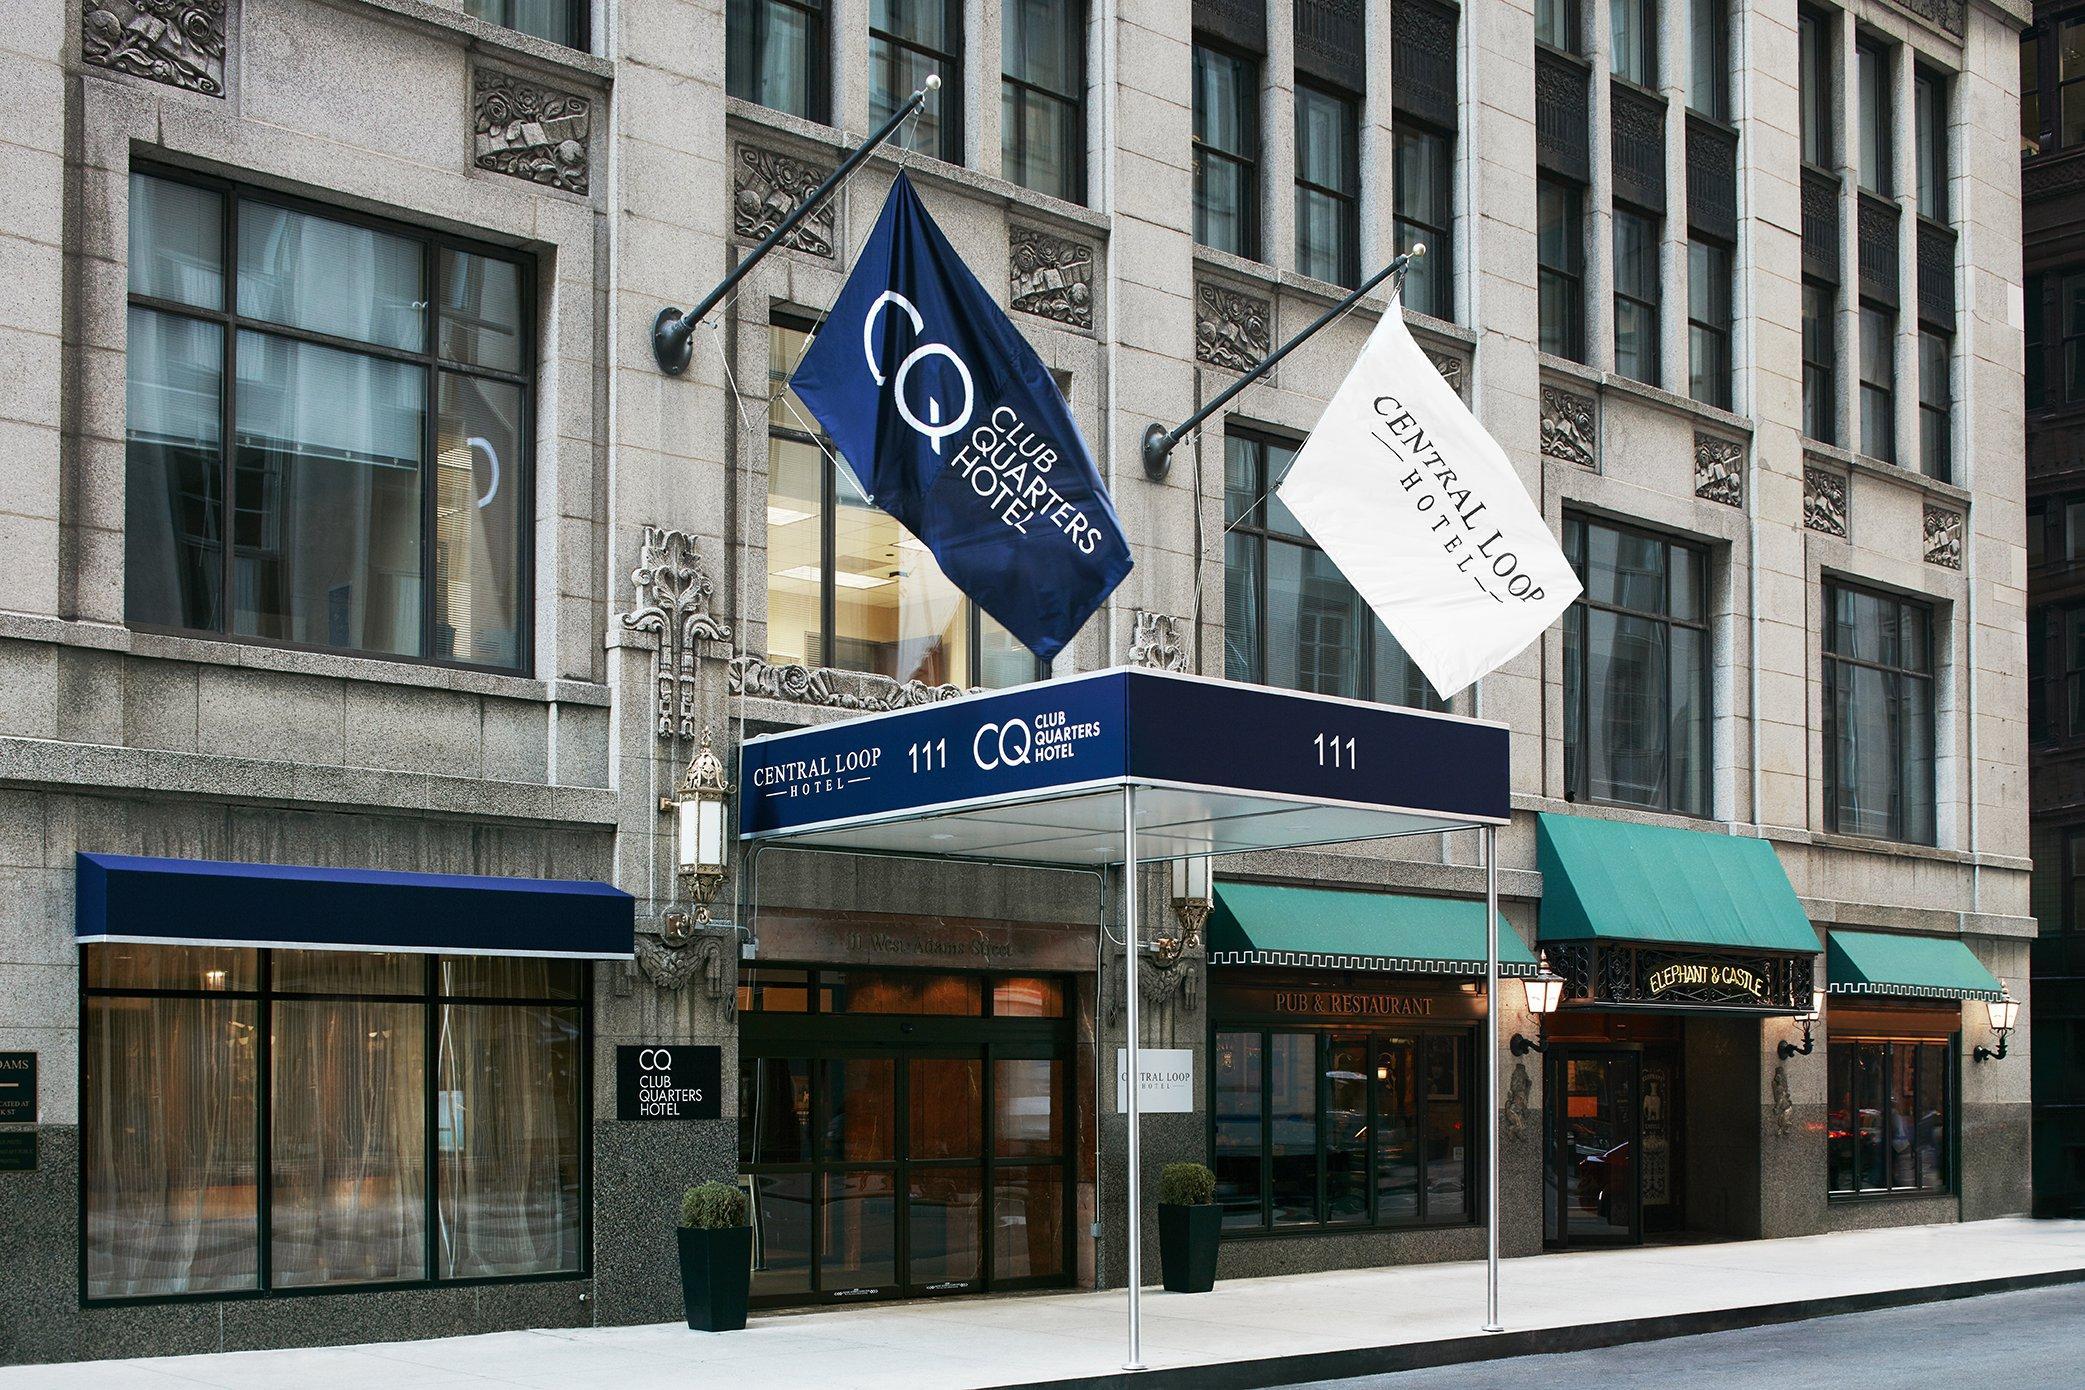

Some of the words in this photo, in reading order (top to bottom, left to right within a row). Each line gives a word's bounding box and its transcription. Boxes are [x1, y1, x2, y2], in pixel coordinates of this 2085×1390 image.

[864, 290, 974, 455] CQ
[992, 406, 1058, 473] CLUB
[951, 445, 1035, 534] HOTEL
[972, 427, 1102, 554] QUARTERS
[1373, 396, 1486, 531] CENTRAL
[1477, 529, 1545, 602] LOOP
[1400, 468, 1473, 573] HOTEL
[1034, 711, 1066, 730] CLUB
[973, 718, 1031, 771] CQ
[1034, 721, 1101, 746] QUARTERS
[908, 738, 946, 774] 111
[1035, 743, 1075, 763] HOTEL
[1314, 733, 1355, 770] 111
[753, 757, 831, 787] CENTRAL
[835, 747, 882, 773] LOOP
[790, 778, 844, 798] HOTEL
[869, 934, 906, 953] West
[913, 936, 965, 955] Adams
[969, 938, 1014, 957] Street
[1649, 964, 1709, 993] ELEPHANT
[1711, 966, 1722, 985] &
[1722, 966, 1764, 997] CASTLE
[1275, 993, 1308, 1012] PUB
[1313, 993, 1325, 1012] &
[1331, 994, 1433, 1016] RESTAURANT
[639, 1049, 672, 1071] CQ
[639, 1075, 672, 1088] CLUB
[1121, 1072, 1163, 1082] CTRAL
[1166, 1072, 1191, 1082] LOOP
[1141, 1082, 1170, 1090] HOTEL
[639, 1088, 703, 1102] QUARTERS
[640, 1102, 680, 1116] HOTEL
